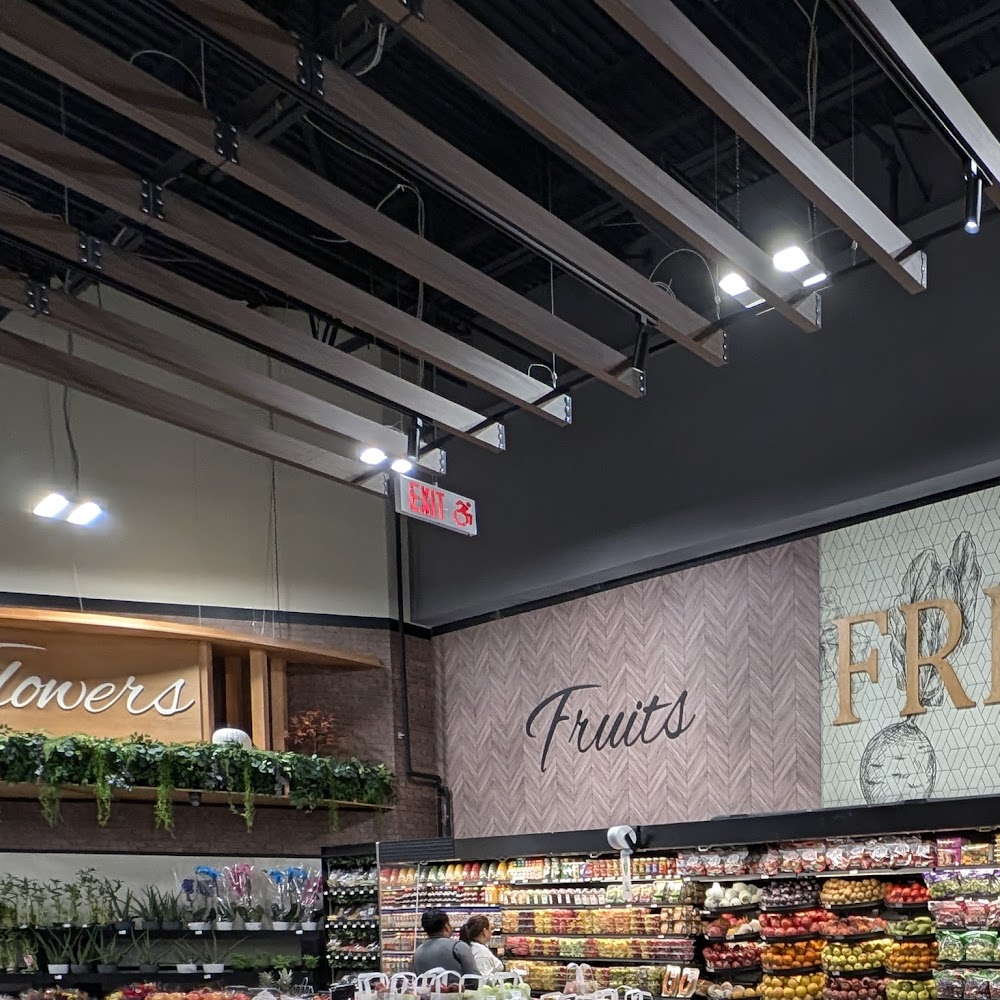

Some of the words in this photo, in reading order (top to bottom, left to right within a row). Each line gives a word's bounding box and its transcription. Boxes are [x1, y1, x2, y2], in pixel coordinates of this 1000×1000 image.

[408, 481, 444, 520] EXIT
[0, 642, 196, 716] lowers
[525, 684, 696, 773] Fruits
